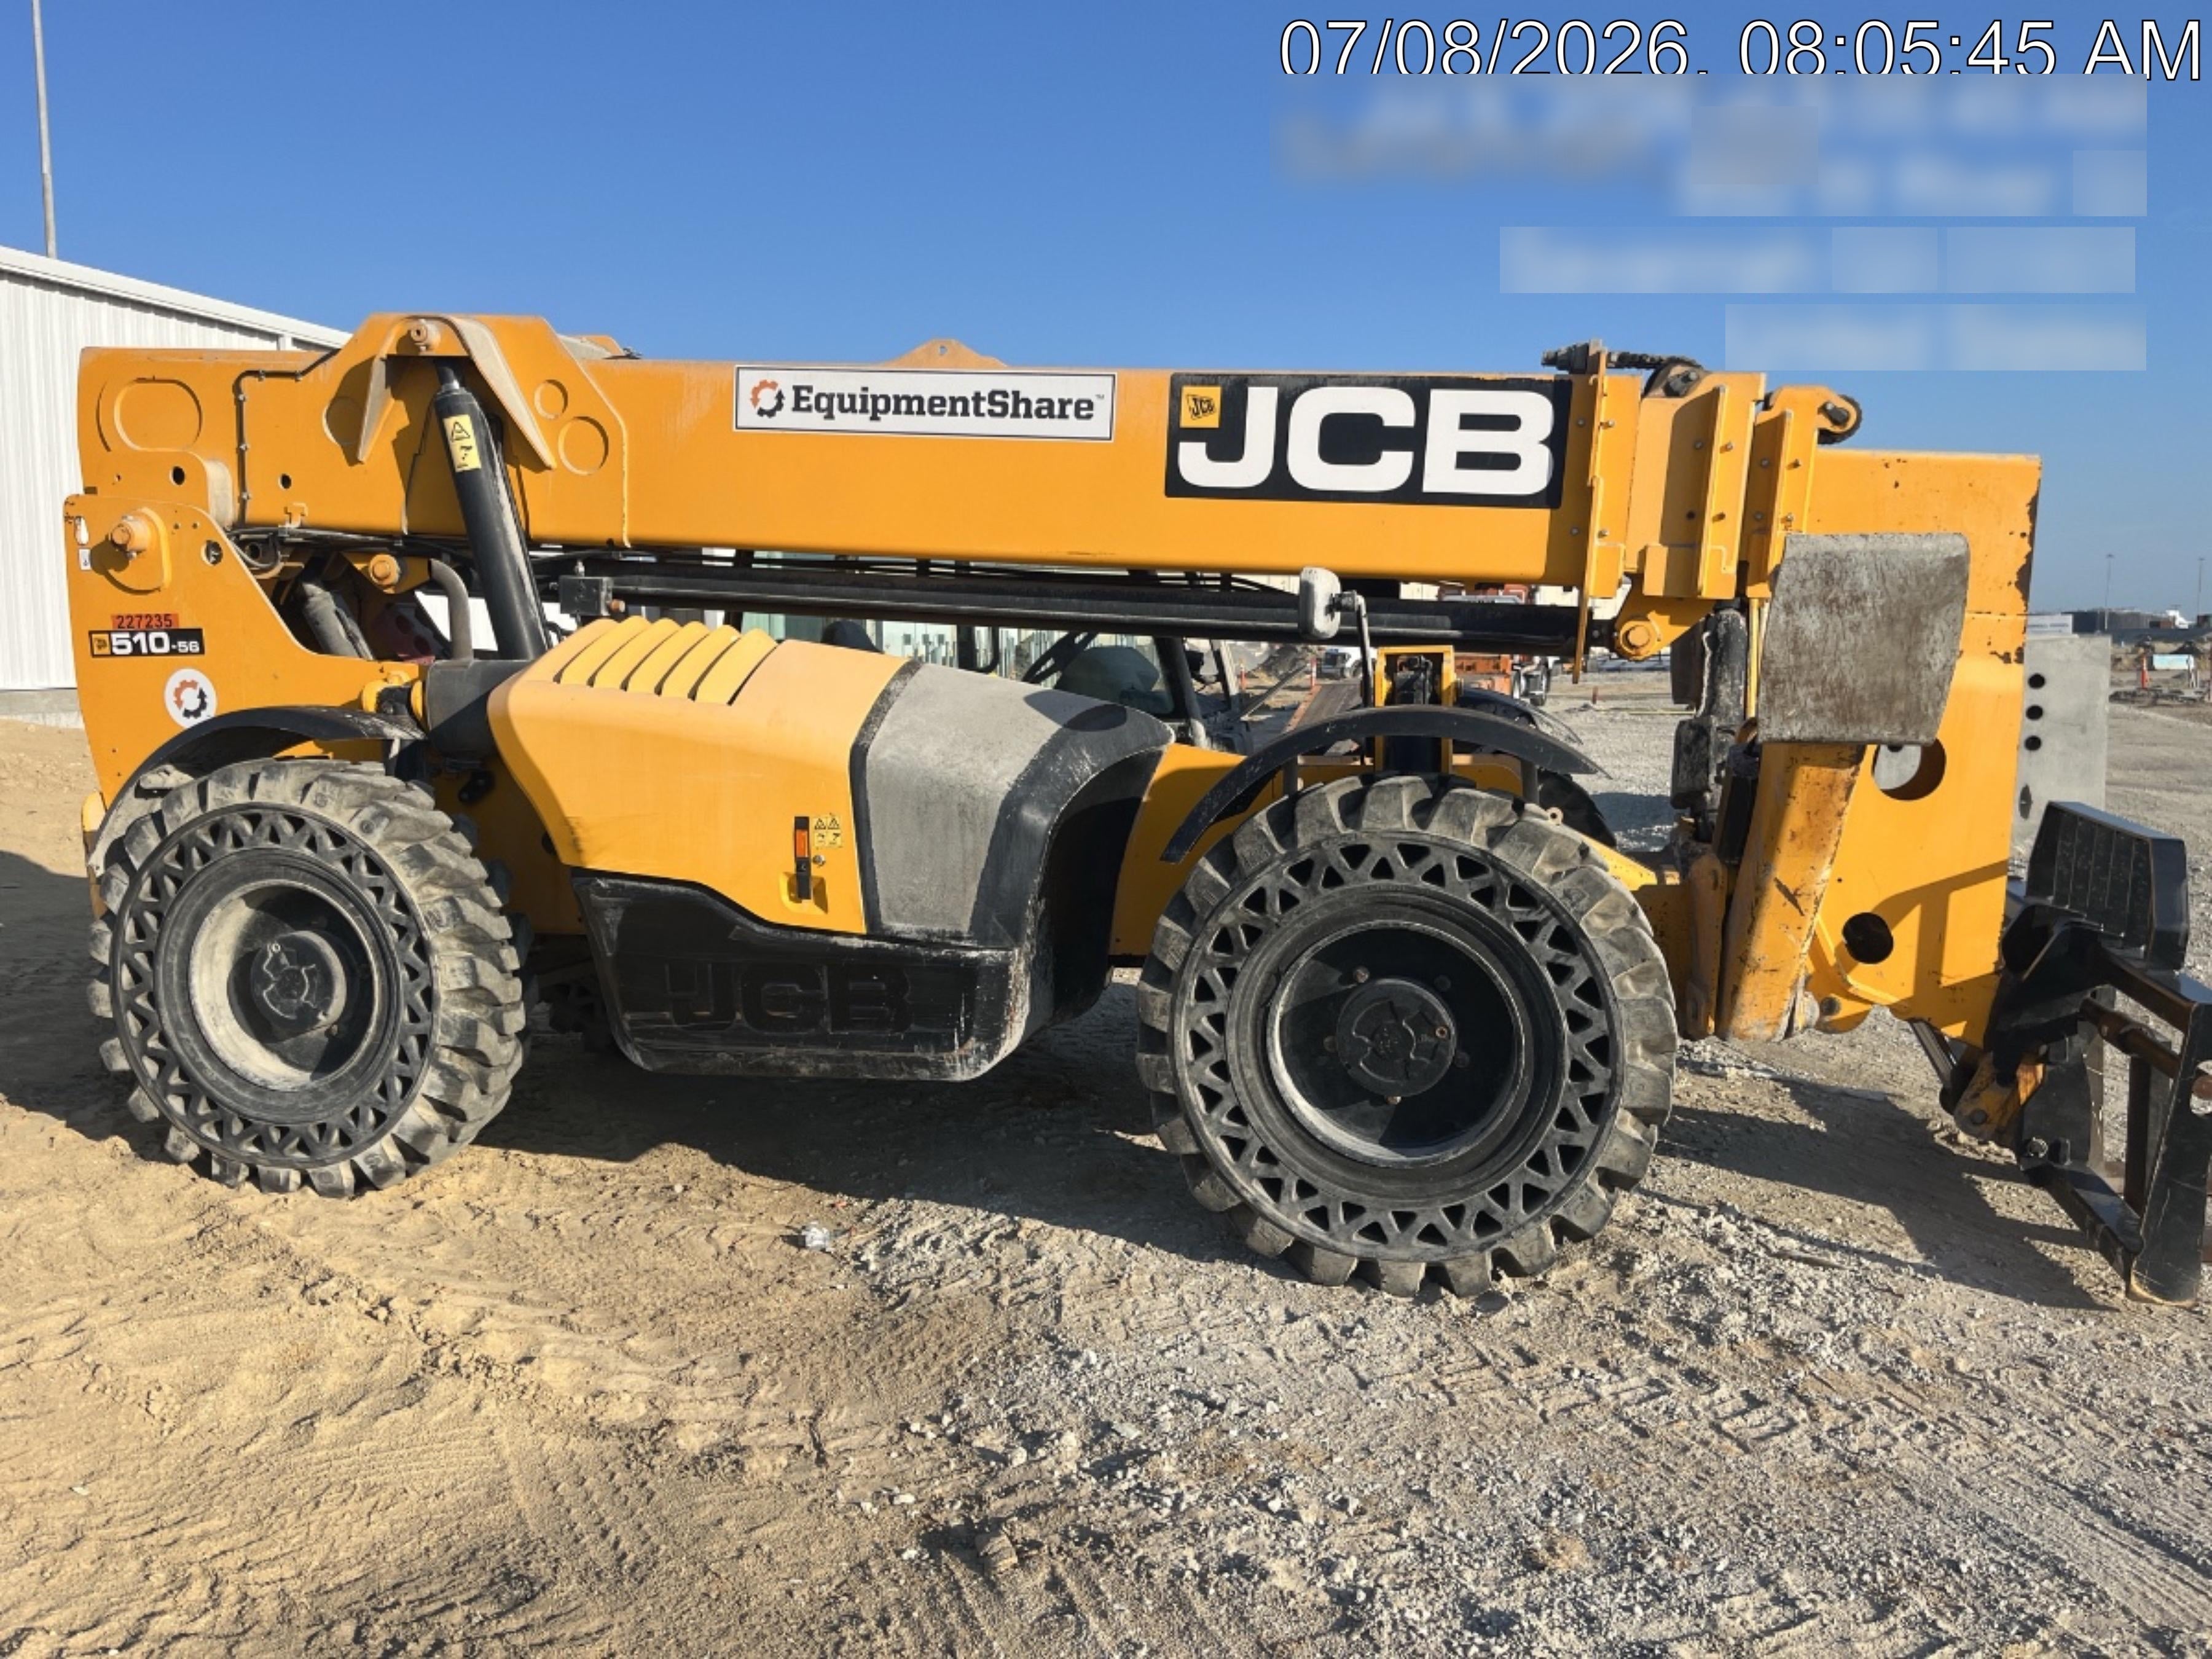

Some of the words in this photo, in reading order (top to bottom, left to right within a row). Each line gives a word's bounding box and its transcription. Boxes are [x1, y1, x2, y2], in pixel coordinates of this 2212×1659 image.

[791, 385, 1094, 422] EquipmentShare
[1178, 386, 1554, 495] JCB
[116, 614, 172, 629] 227235
[667, 962, 912, 1034] JCB
